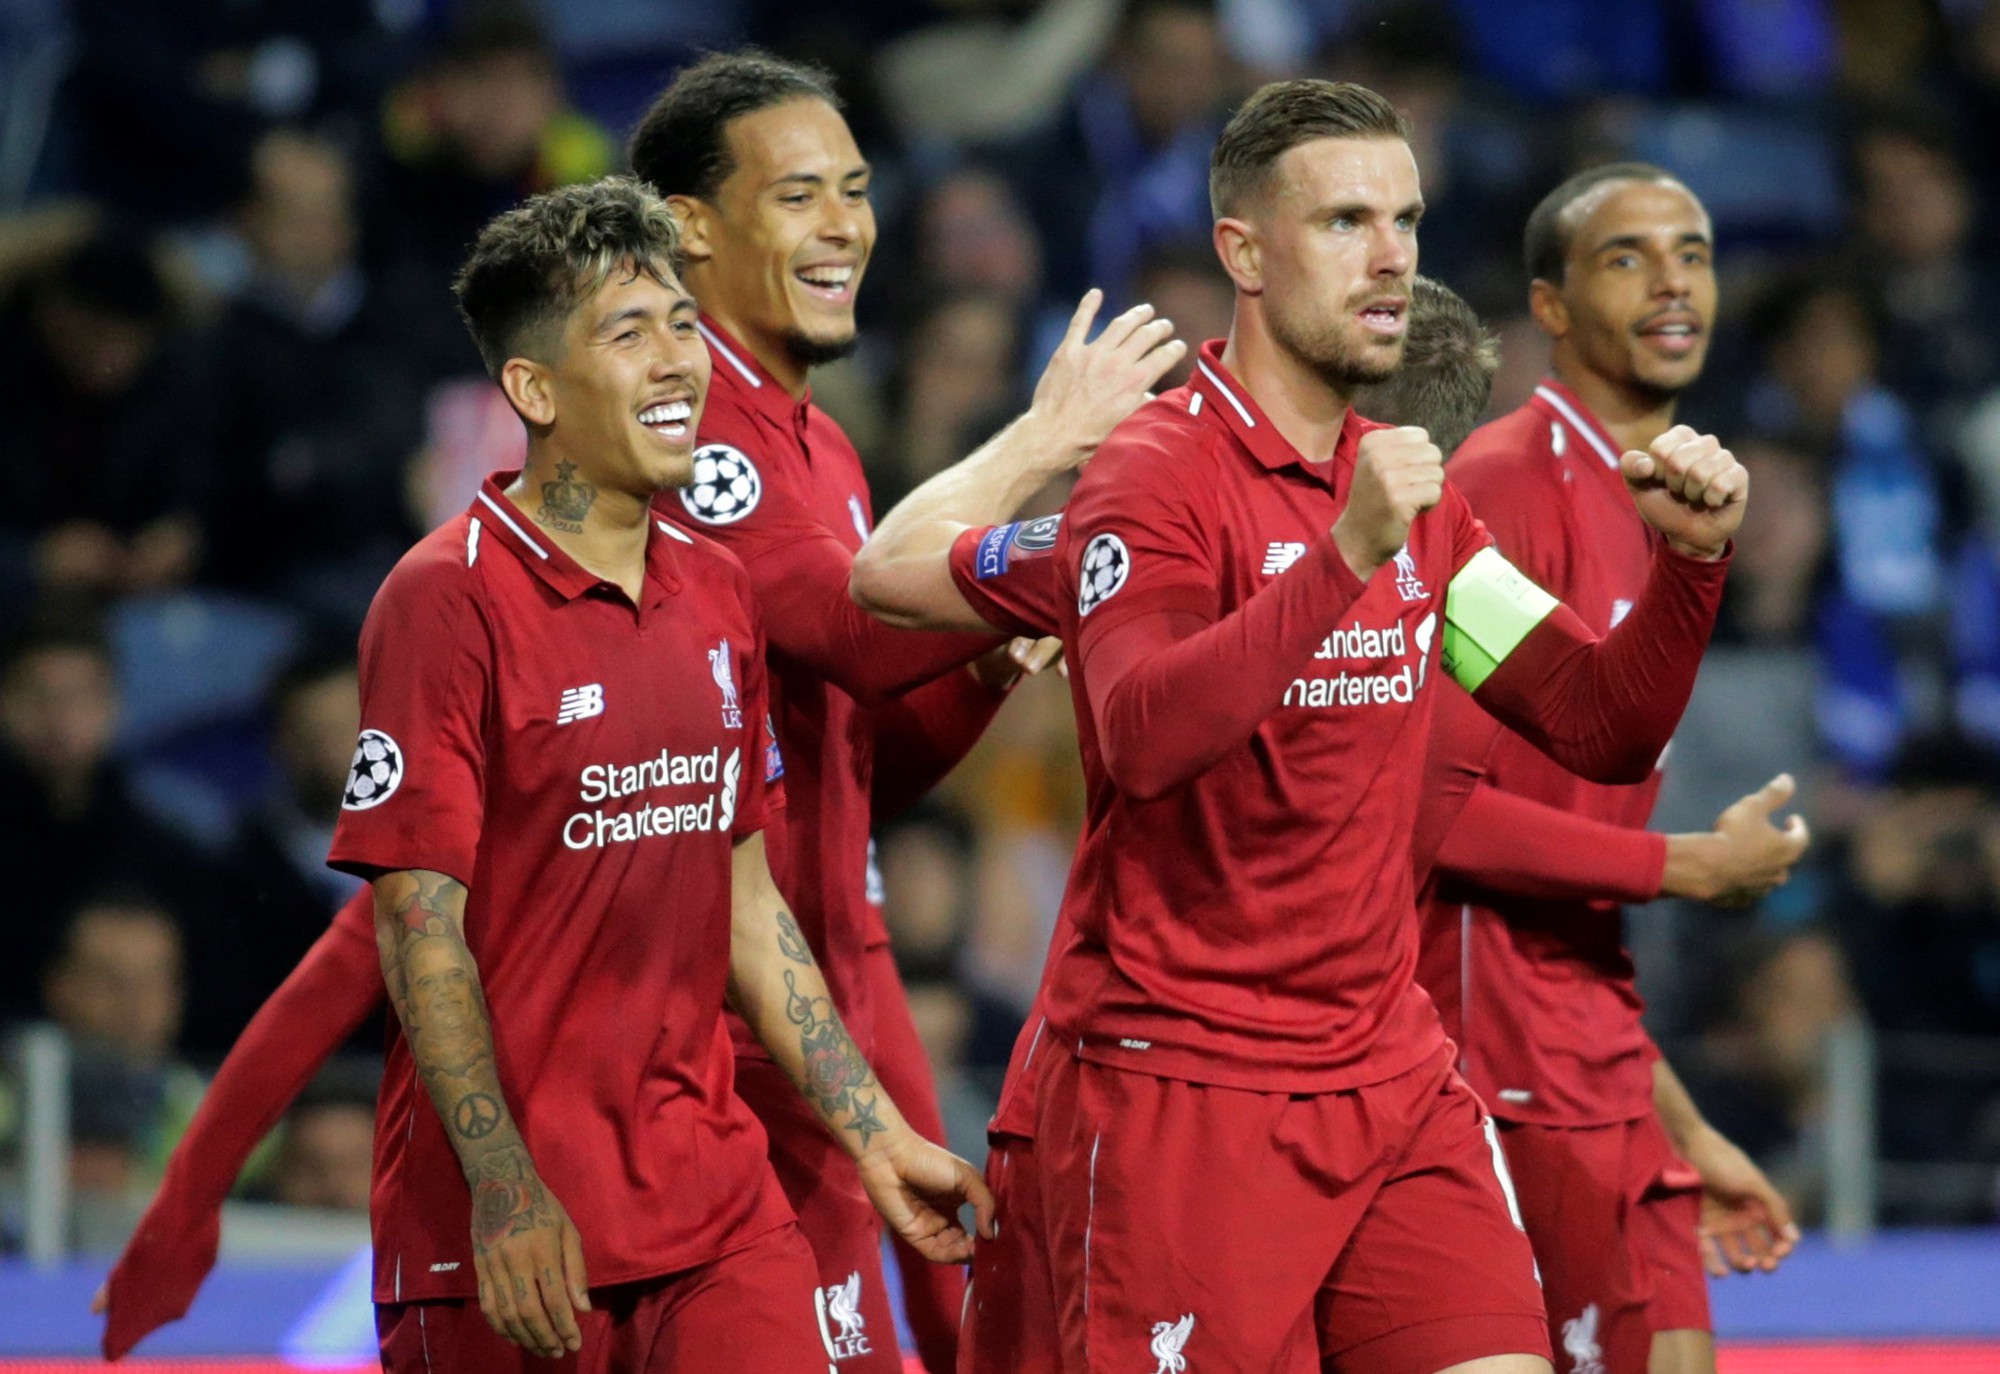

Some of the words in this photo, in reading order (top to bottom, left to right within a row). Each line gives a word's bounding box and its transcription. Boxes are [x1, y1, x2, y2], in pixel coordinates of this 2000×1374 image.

[1313, 619, 1406, 660] andard
[1283, 664, 1414, 708] hartered
[580, 746, 719, 802] Standard
[563, 794, 715, 850] Chartered
